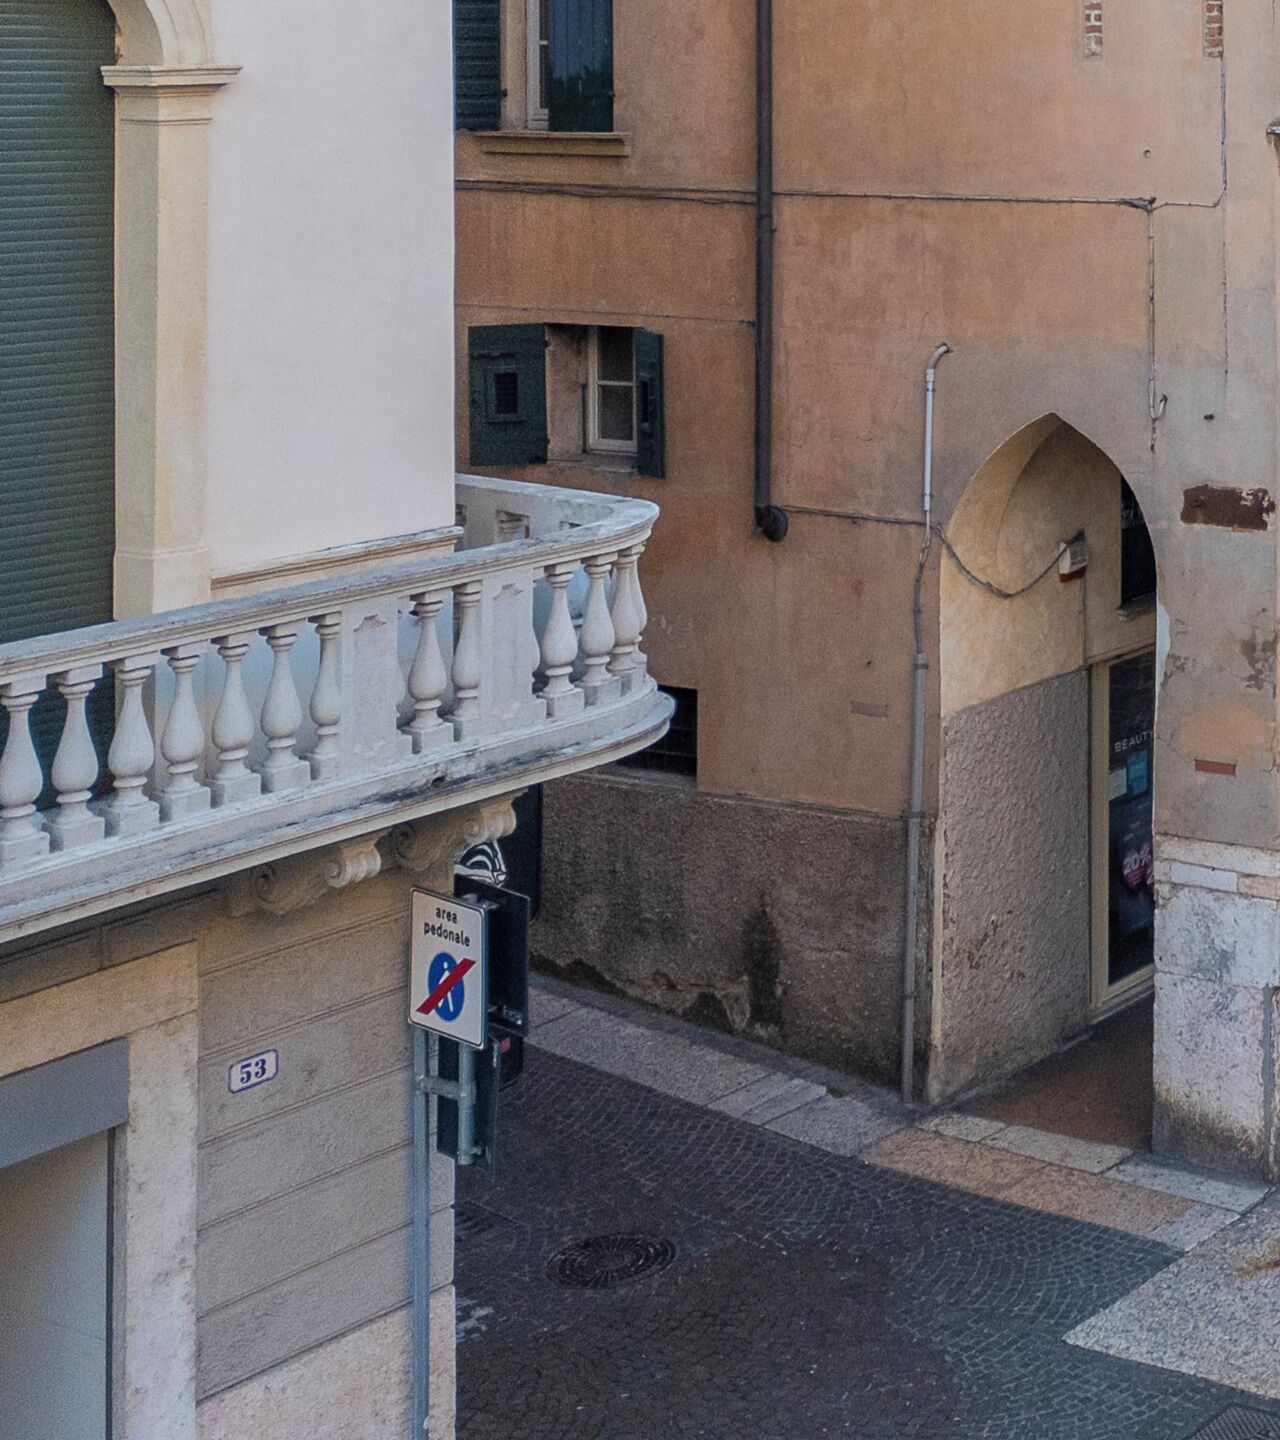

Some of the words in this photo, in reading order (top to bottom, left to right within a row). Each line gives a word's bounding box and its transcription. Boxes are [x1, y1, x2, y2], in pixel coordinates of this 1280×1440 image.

[435, 907, 458, 924] area
[424, 922, 470, 947] pedonale
[240, 1058, 266, 1084] 53
